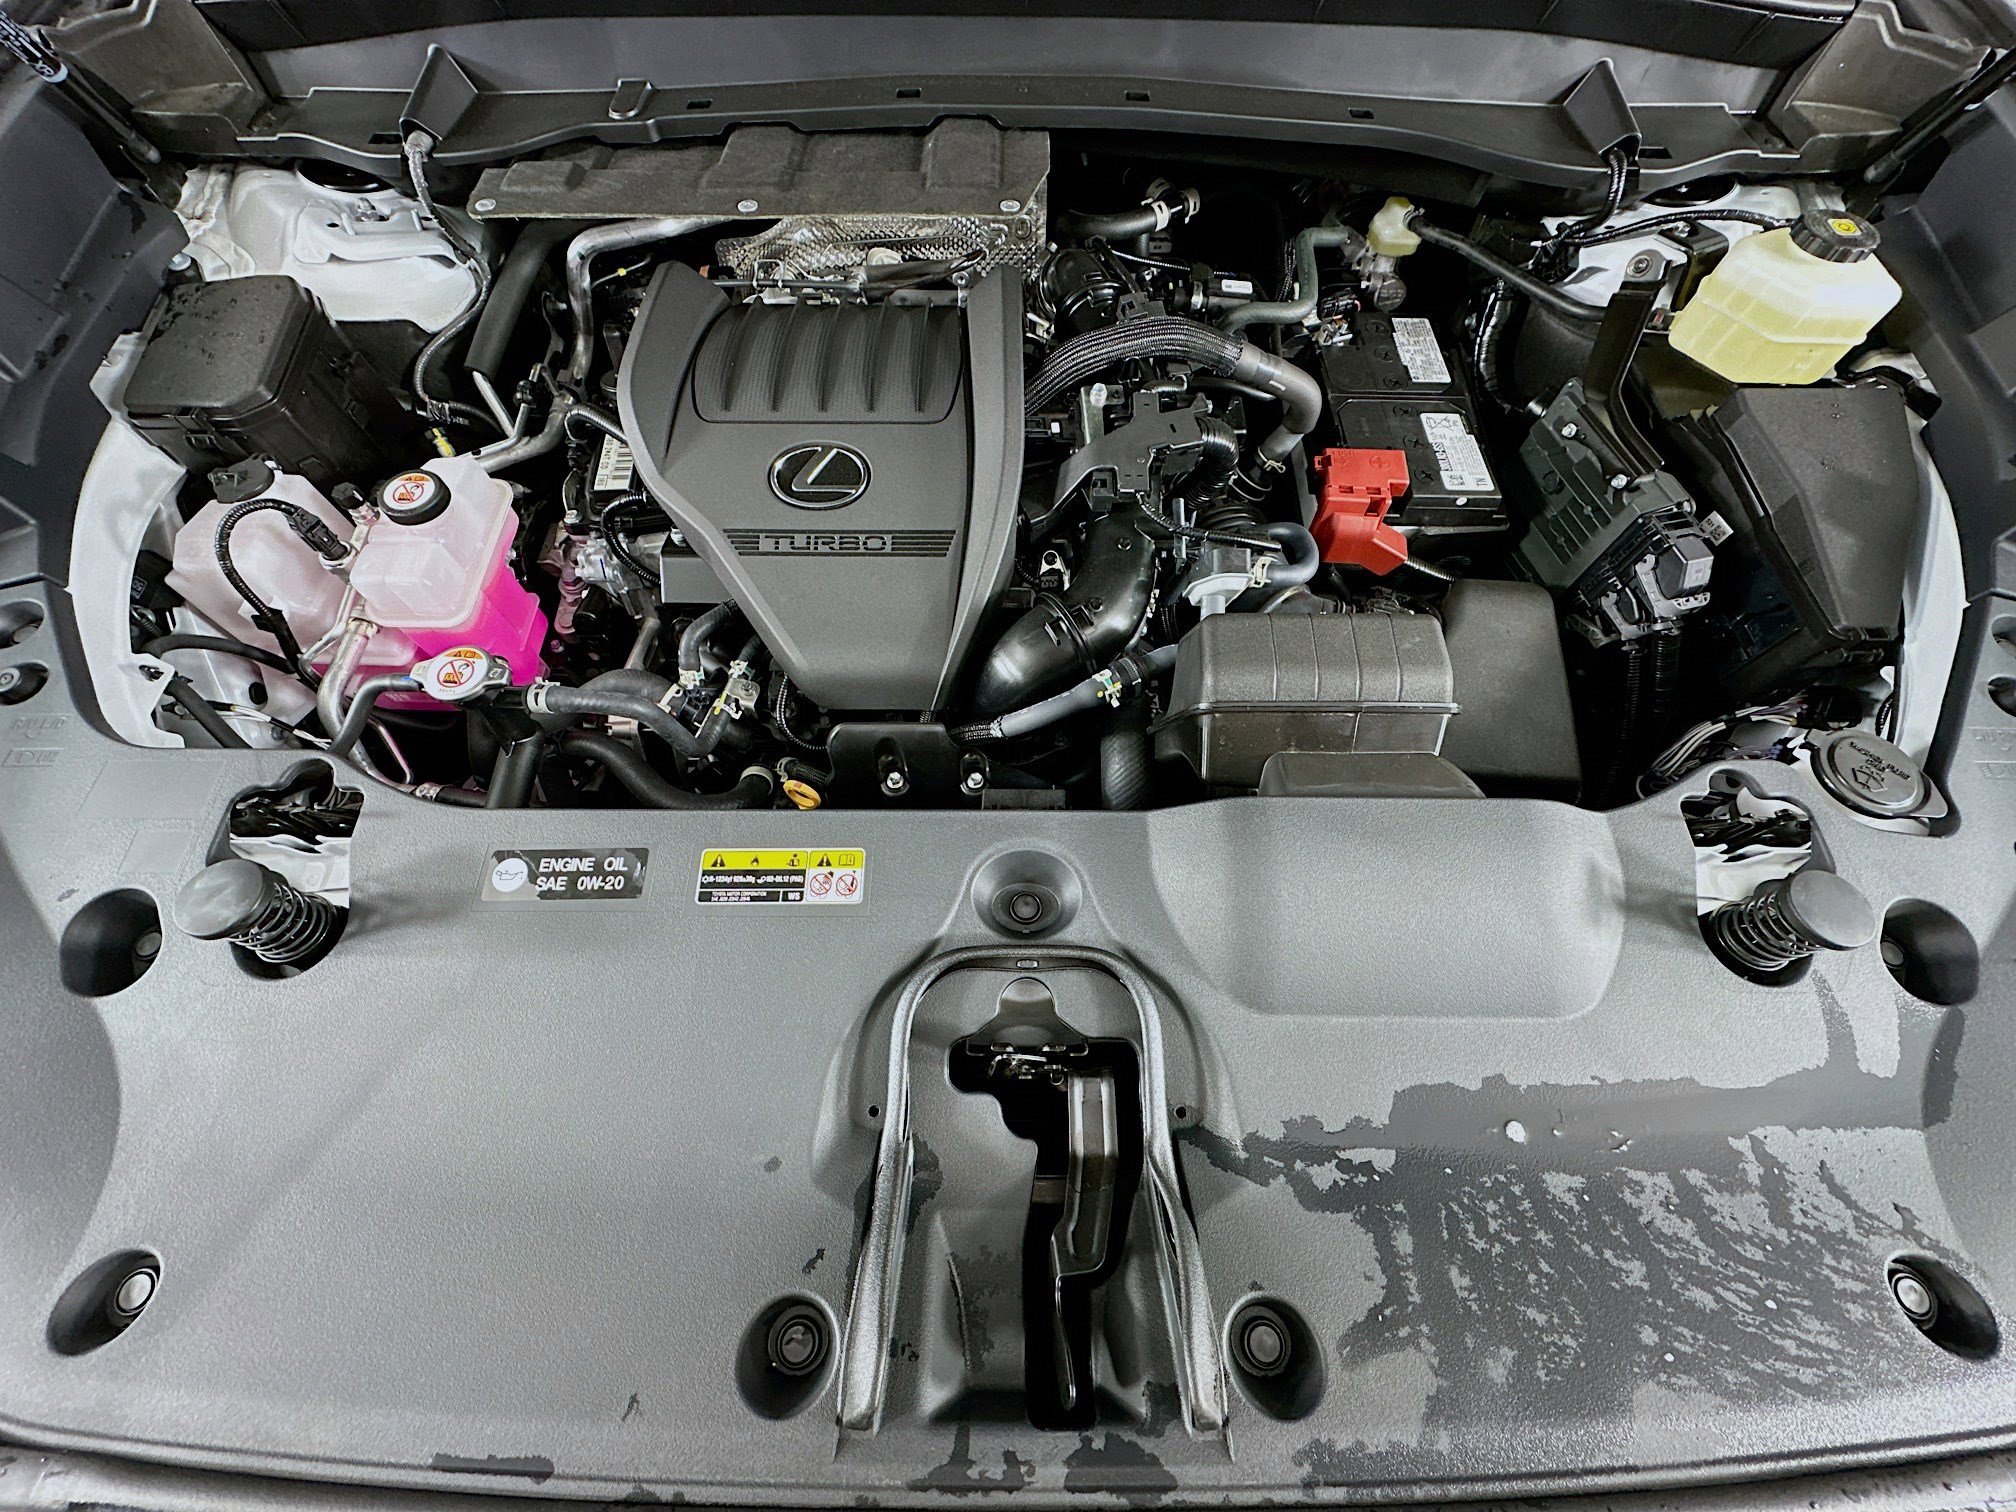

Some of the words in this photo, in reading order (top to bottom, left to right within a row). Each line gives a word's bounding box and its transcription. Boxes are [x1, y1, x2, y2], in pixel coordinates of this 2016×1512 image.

[764, 535, 888, 551] TURBO
[539, 857, 596, 872] ENGINE
[603, 857, 628, 871] OIL
[535, 876, 567, 891] SAE
[577, 875, 625, 890] 0W-20
[788, 892, 801, 900] WS
